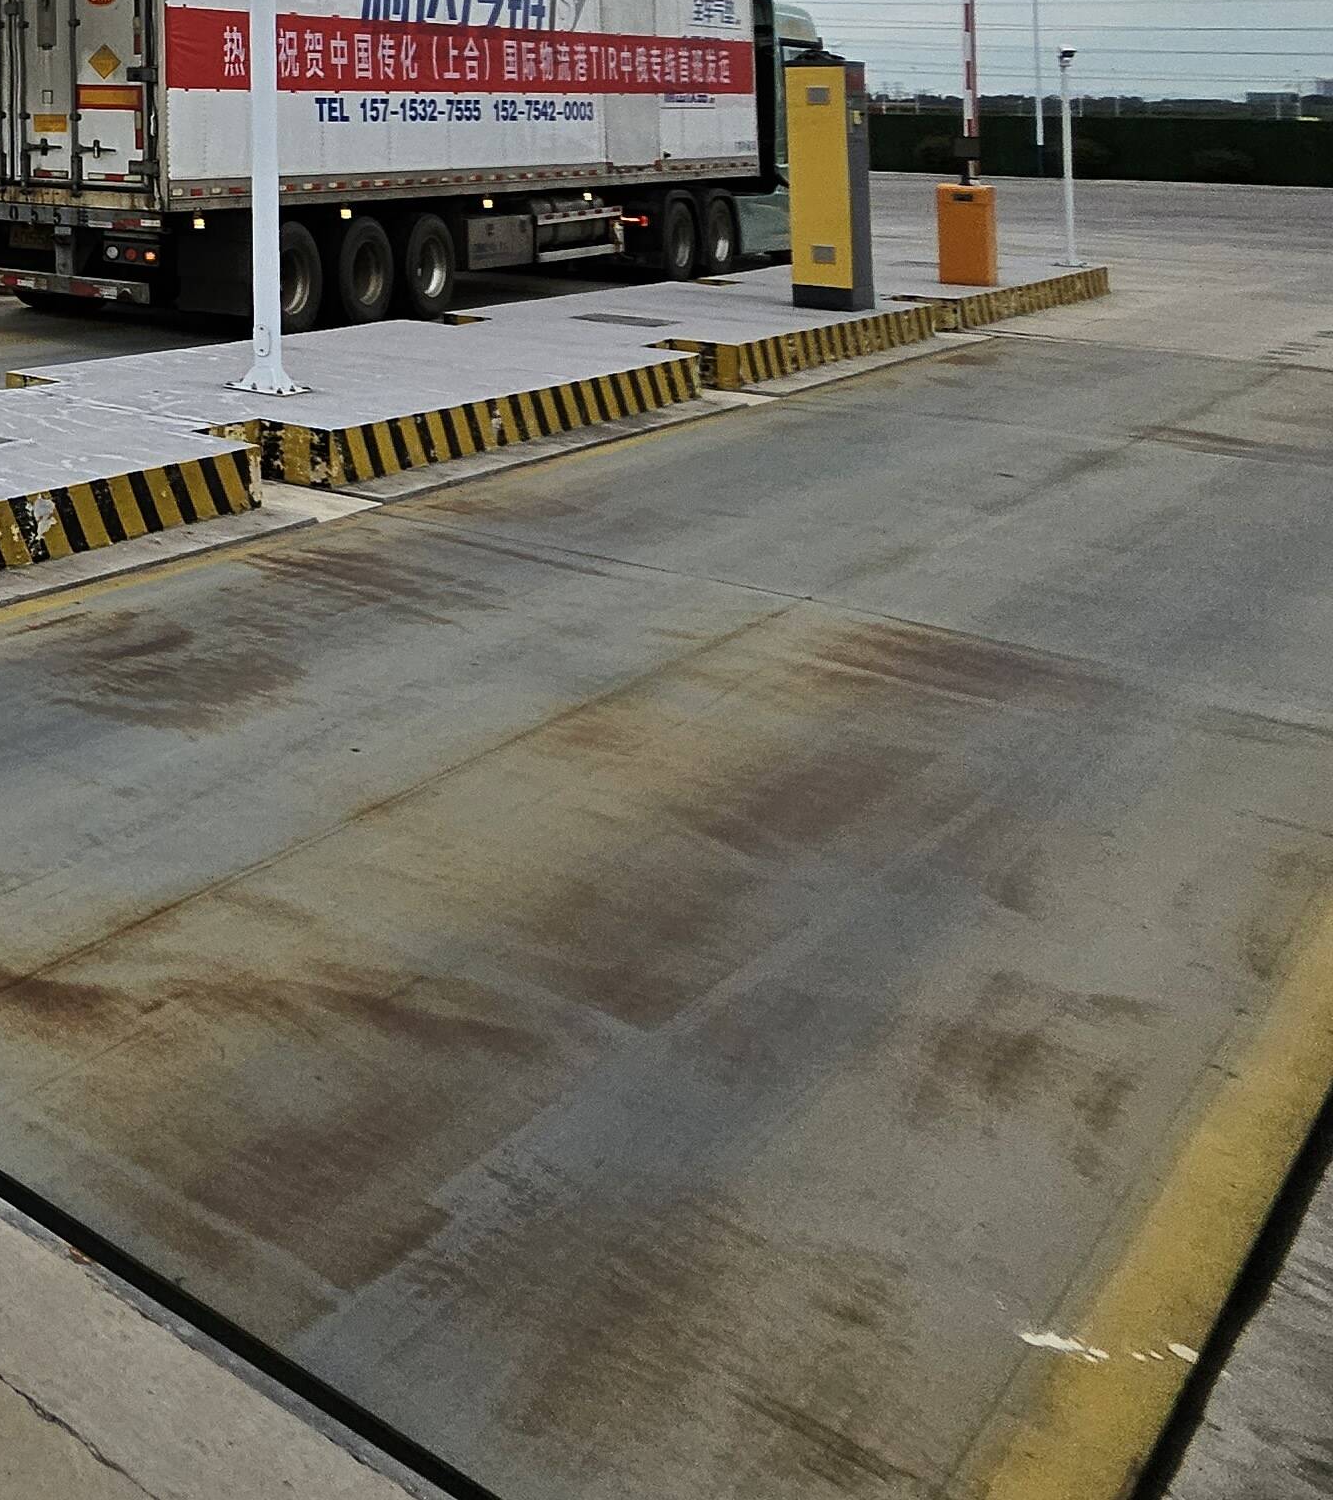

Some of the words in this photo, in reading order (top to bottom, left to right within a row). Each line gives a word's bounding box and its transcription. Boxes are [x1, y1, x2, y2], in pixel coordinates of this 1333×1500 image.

[315, 97, 349, 123] TEL
[360, 98, 482, 122] 157-1532-7555
[493, 99, 595, 122] 152-7542-0003
